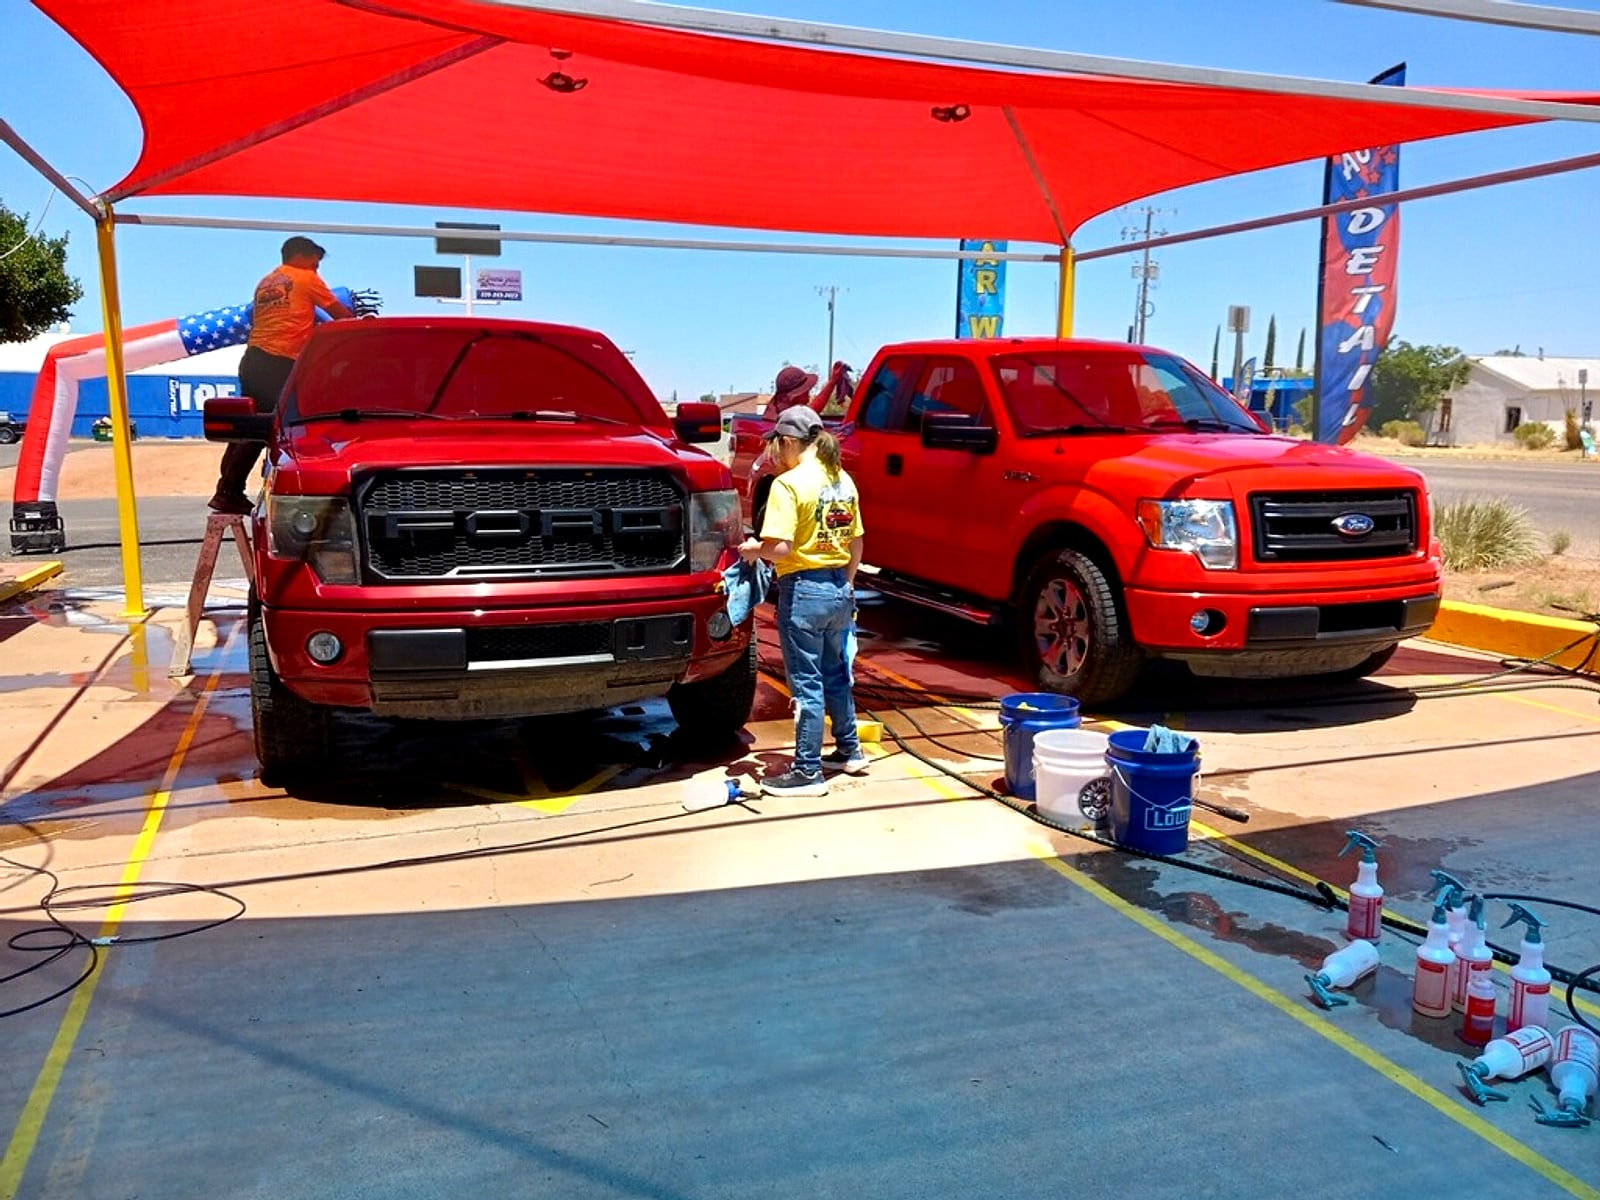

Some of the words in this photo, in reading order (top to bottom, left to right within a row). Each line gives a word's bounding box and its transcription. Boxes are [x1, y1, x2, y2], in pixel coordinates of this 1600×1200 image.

[1342, 147, 1374, 181] AU
[1337, 207, 1386, 427] DETAIL
[385, 508, 676, 538] FORD
[1153, 810, 1189, 827] LOW
